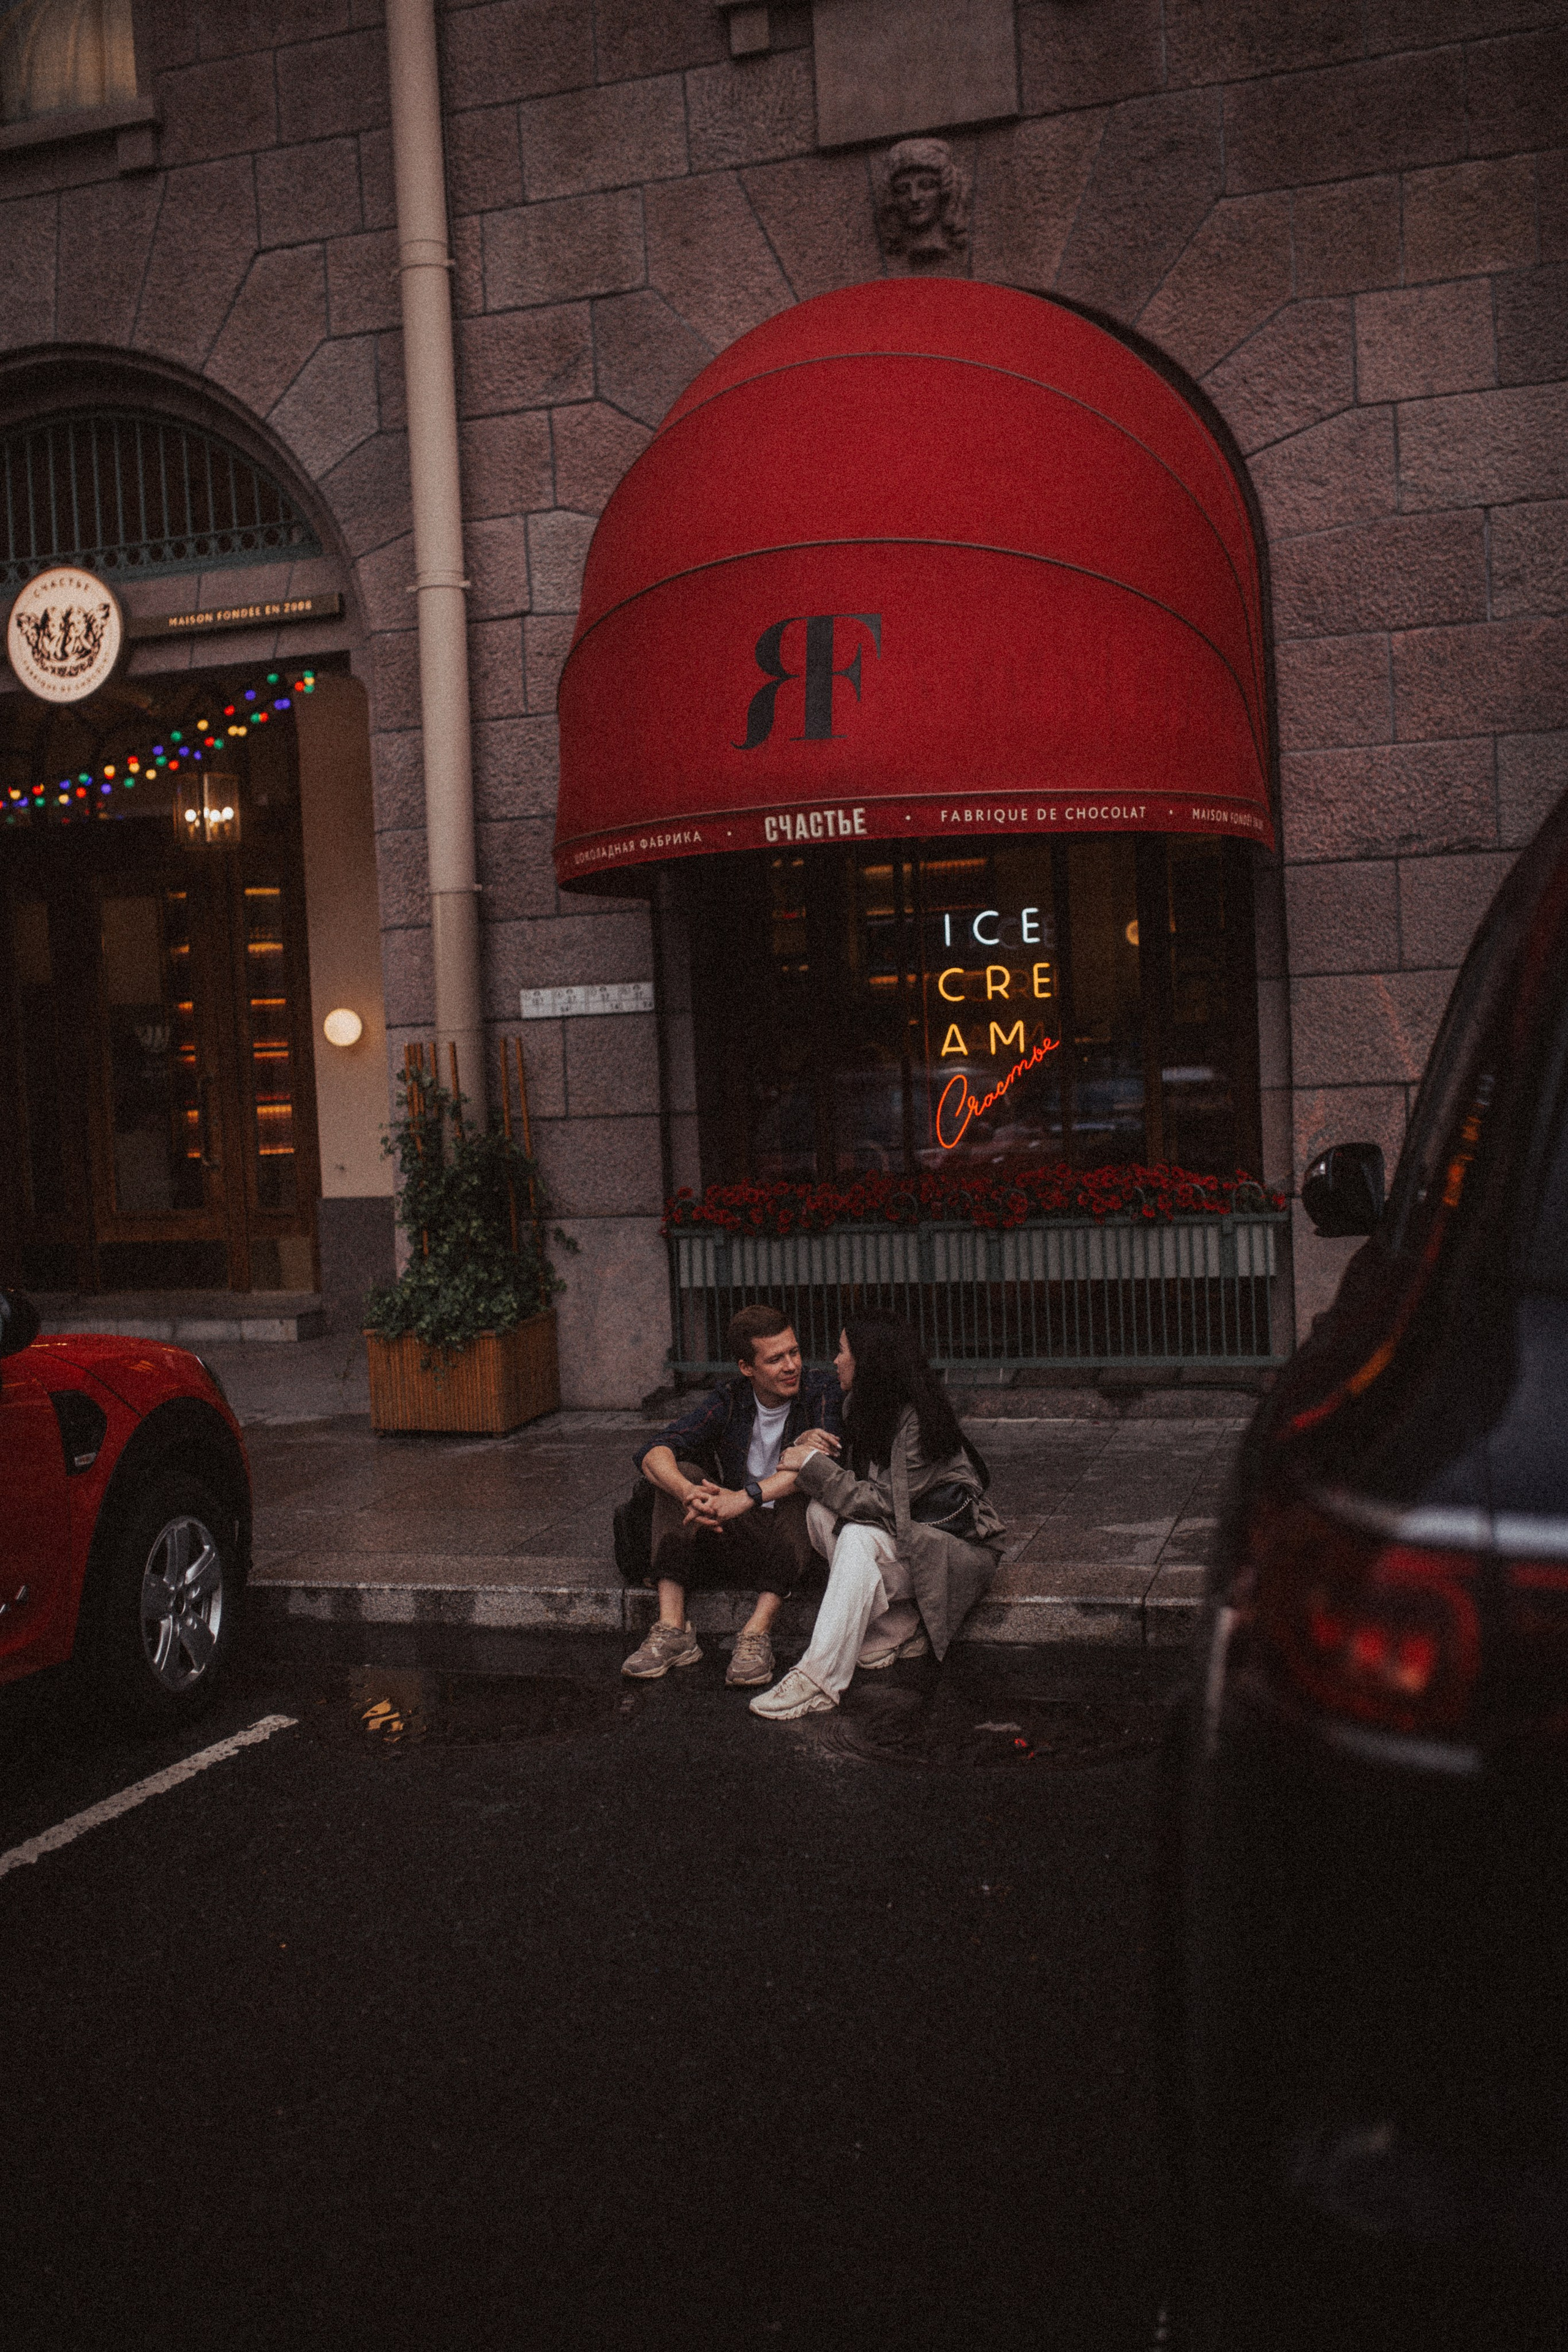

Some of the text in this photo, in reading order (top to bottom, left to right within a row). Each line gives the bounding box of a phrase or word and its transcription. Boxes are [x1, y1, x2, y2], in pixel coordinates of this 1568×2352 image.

[168, 613, 214, 627] MAISON
[265, 604, 281, 616] EN
[284, 600, 312, 613] 2008
[764, 807, 867, 842] СЧАСТЬЕ
[941, 806, 1147, 823] FABRIQUE DE CHOCOLAT
[1192, 808, 1229, 822] MAISON
[639, 831, 702, 850] ФАБРИКА
[944, 907, 1041, 948] ICE
[938, 962, 1052, 1002] CRE
[941, 1020, 1026, 1057] AM
